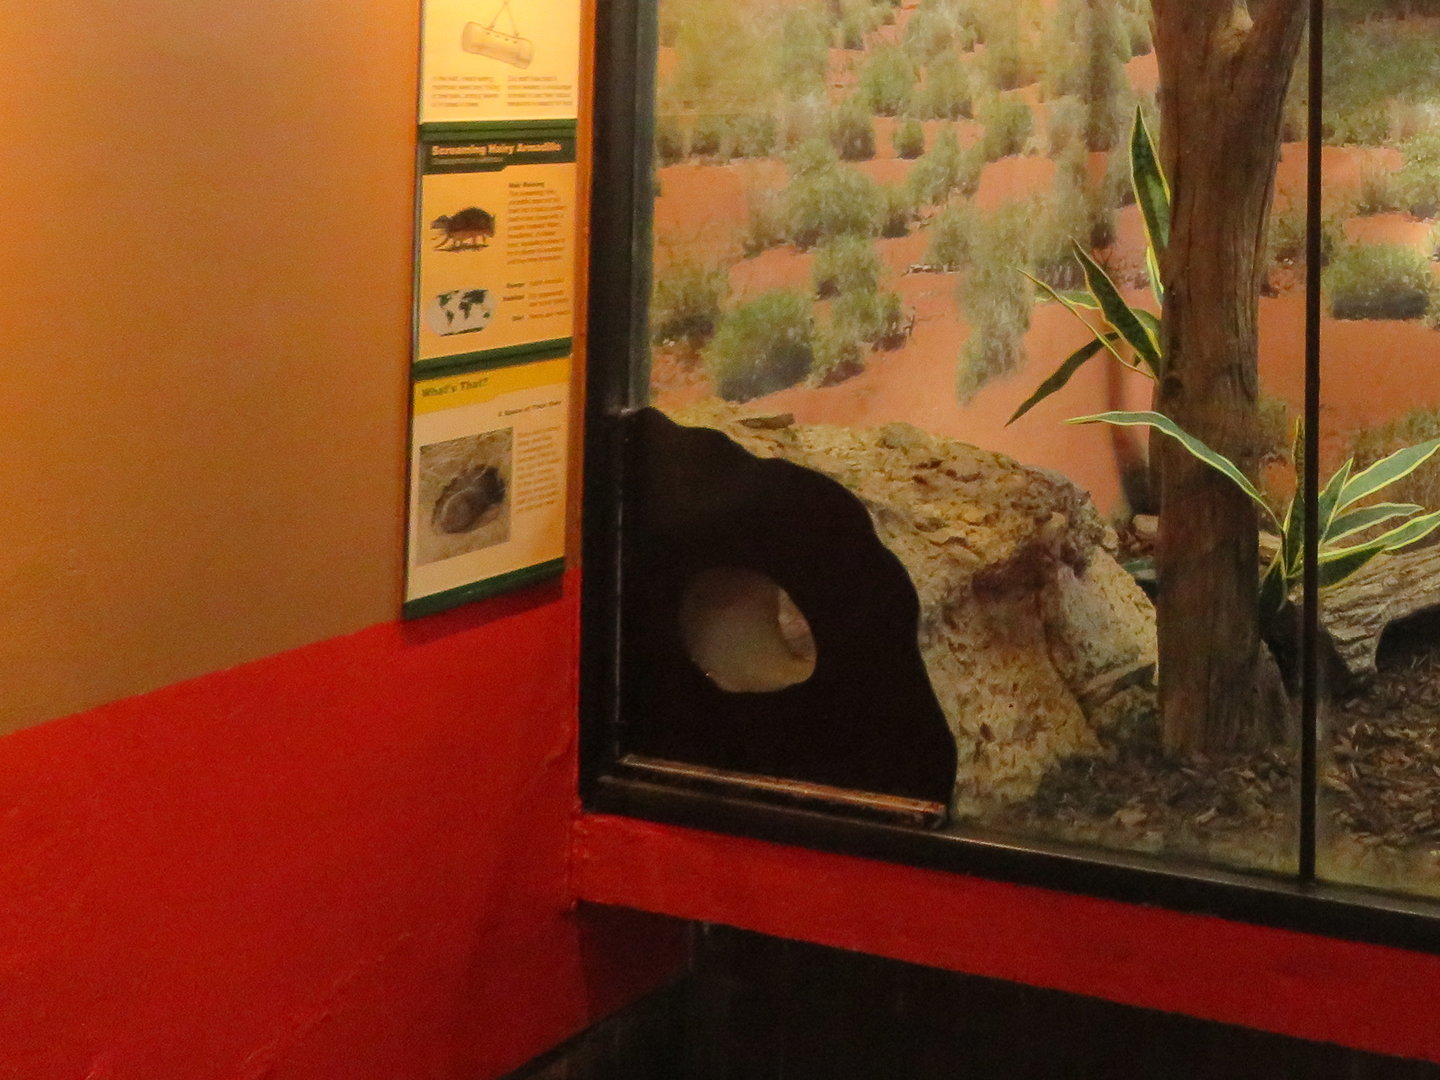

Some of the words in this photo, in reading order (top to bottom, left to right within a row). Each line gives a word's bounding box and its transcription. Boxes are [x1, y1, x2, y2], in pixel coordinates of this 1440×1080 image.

[432, 145, 487, 156] Screaming
[487, 143, 515, 155] Hairy
[517, 141, 562, 152] Armadillo
[422, 383, 457, 397] What's
[460, 377, 489, 391] That?
